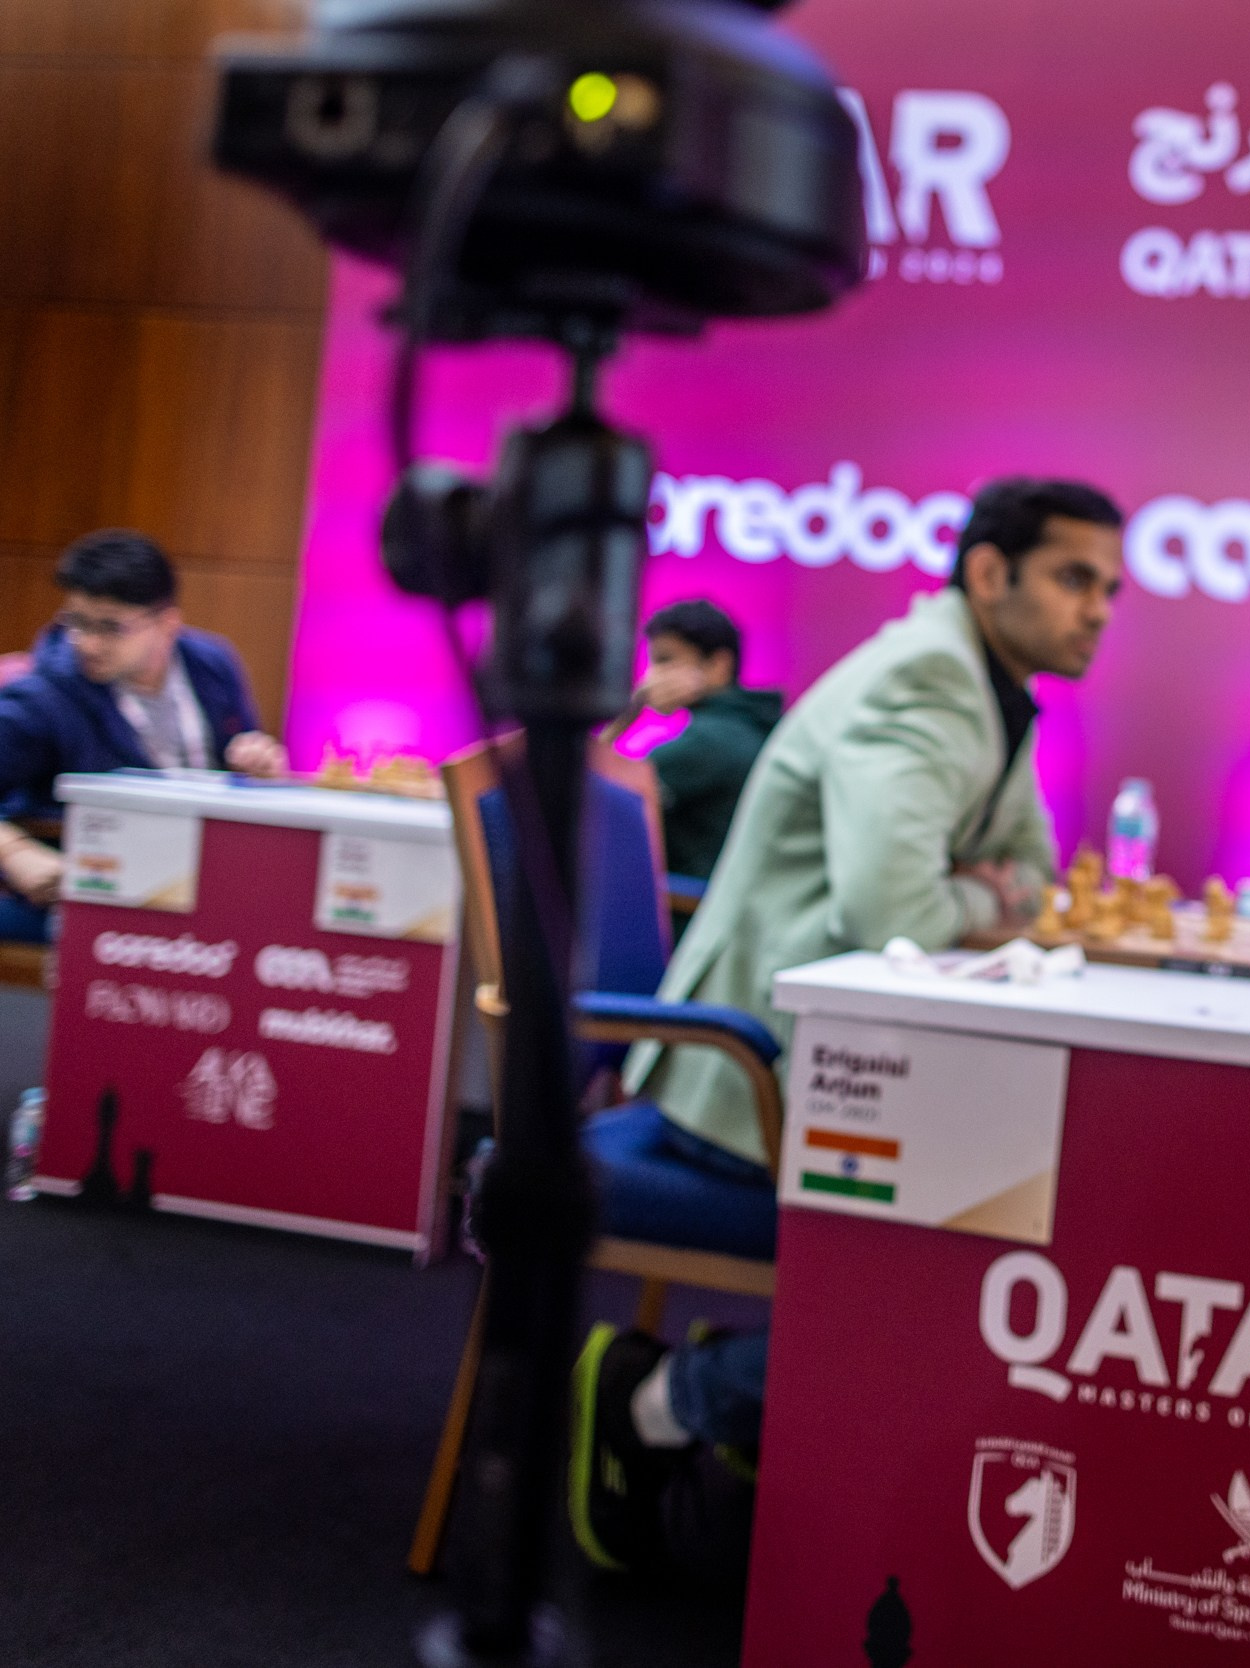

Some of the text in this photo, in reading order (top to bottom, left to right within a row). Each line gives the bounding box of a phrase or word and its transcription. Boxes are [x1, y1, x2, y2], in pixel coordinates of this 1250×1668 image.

[1077, 1382, 1211, 1422] MASTERS
[1122, 1578, 1198, 1617] Ministry
[1198, 1593, 1220, 1616] of
